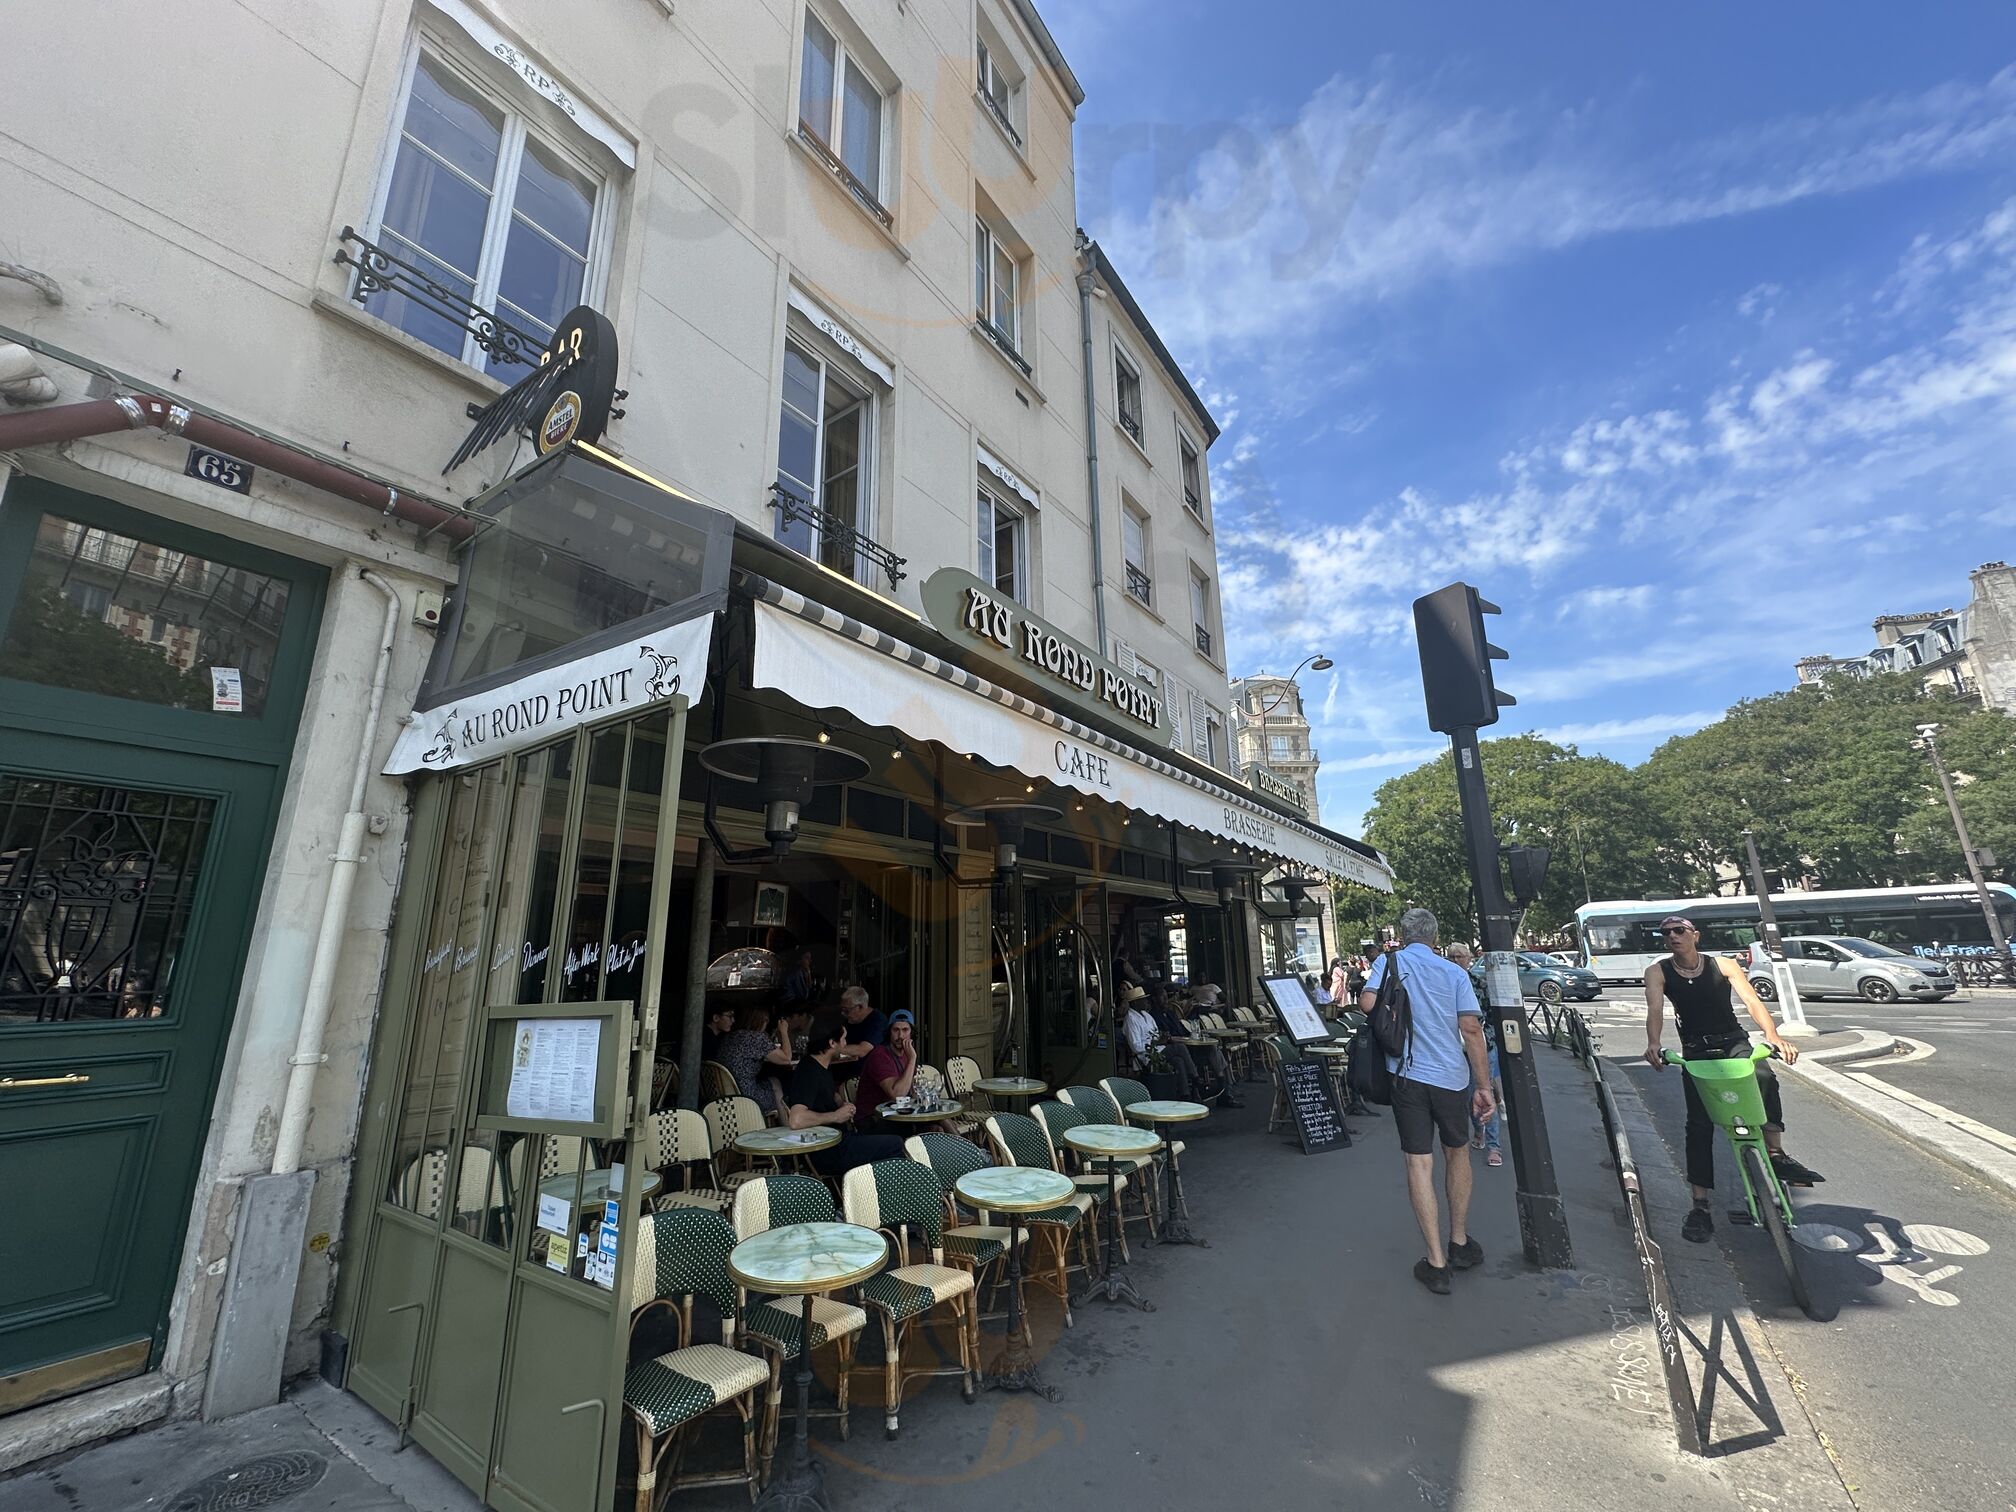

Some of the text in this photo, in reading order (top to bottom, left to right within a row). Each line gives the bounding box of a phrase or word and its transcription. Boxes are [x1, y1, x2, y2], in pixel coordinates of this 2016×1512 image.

[524, 63, 550, 90] RP
[548, 408, 573, 433] AMSTEL
[198, 454, 241, 486] 65
[966, 587, 1163, 729] AU ROND POINT
[461, 668, 633, 748] AU ROND POINT
[1054, 740, 1112, 789] CAFE
[1258, 769, 1299, 806] BRASSERIE
[1223, 807, 1276, 846] BRASSERIE
[522, 941, 549, 973] Dinner
[563, 942, 600, 985] After Work
[606, 943, 625, 975] Plat
